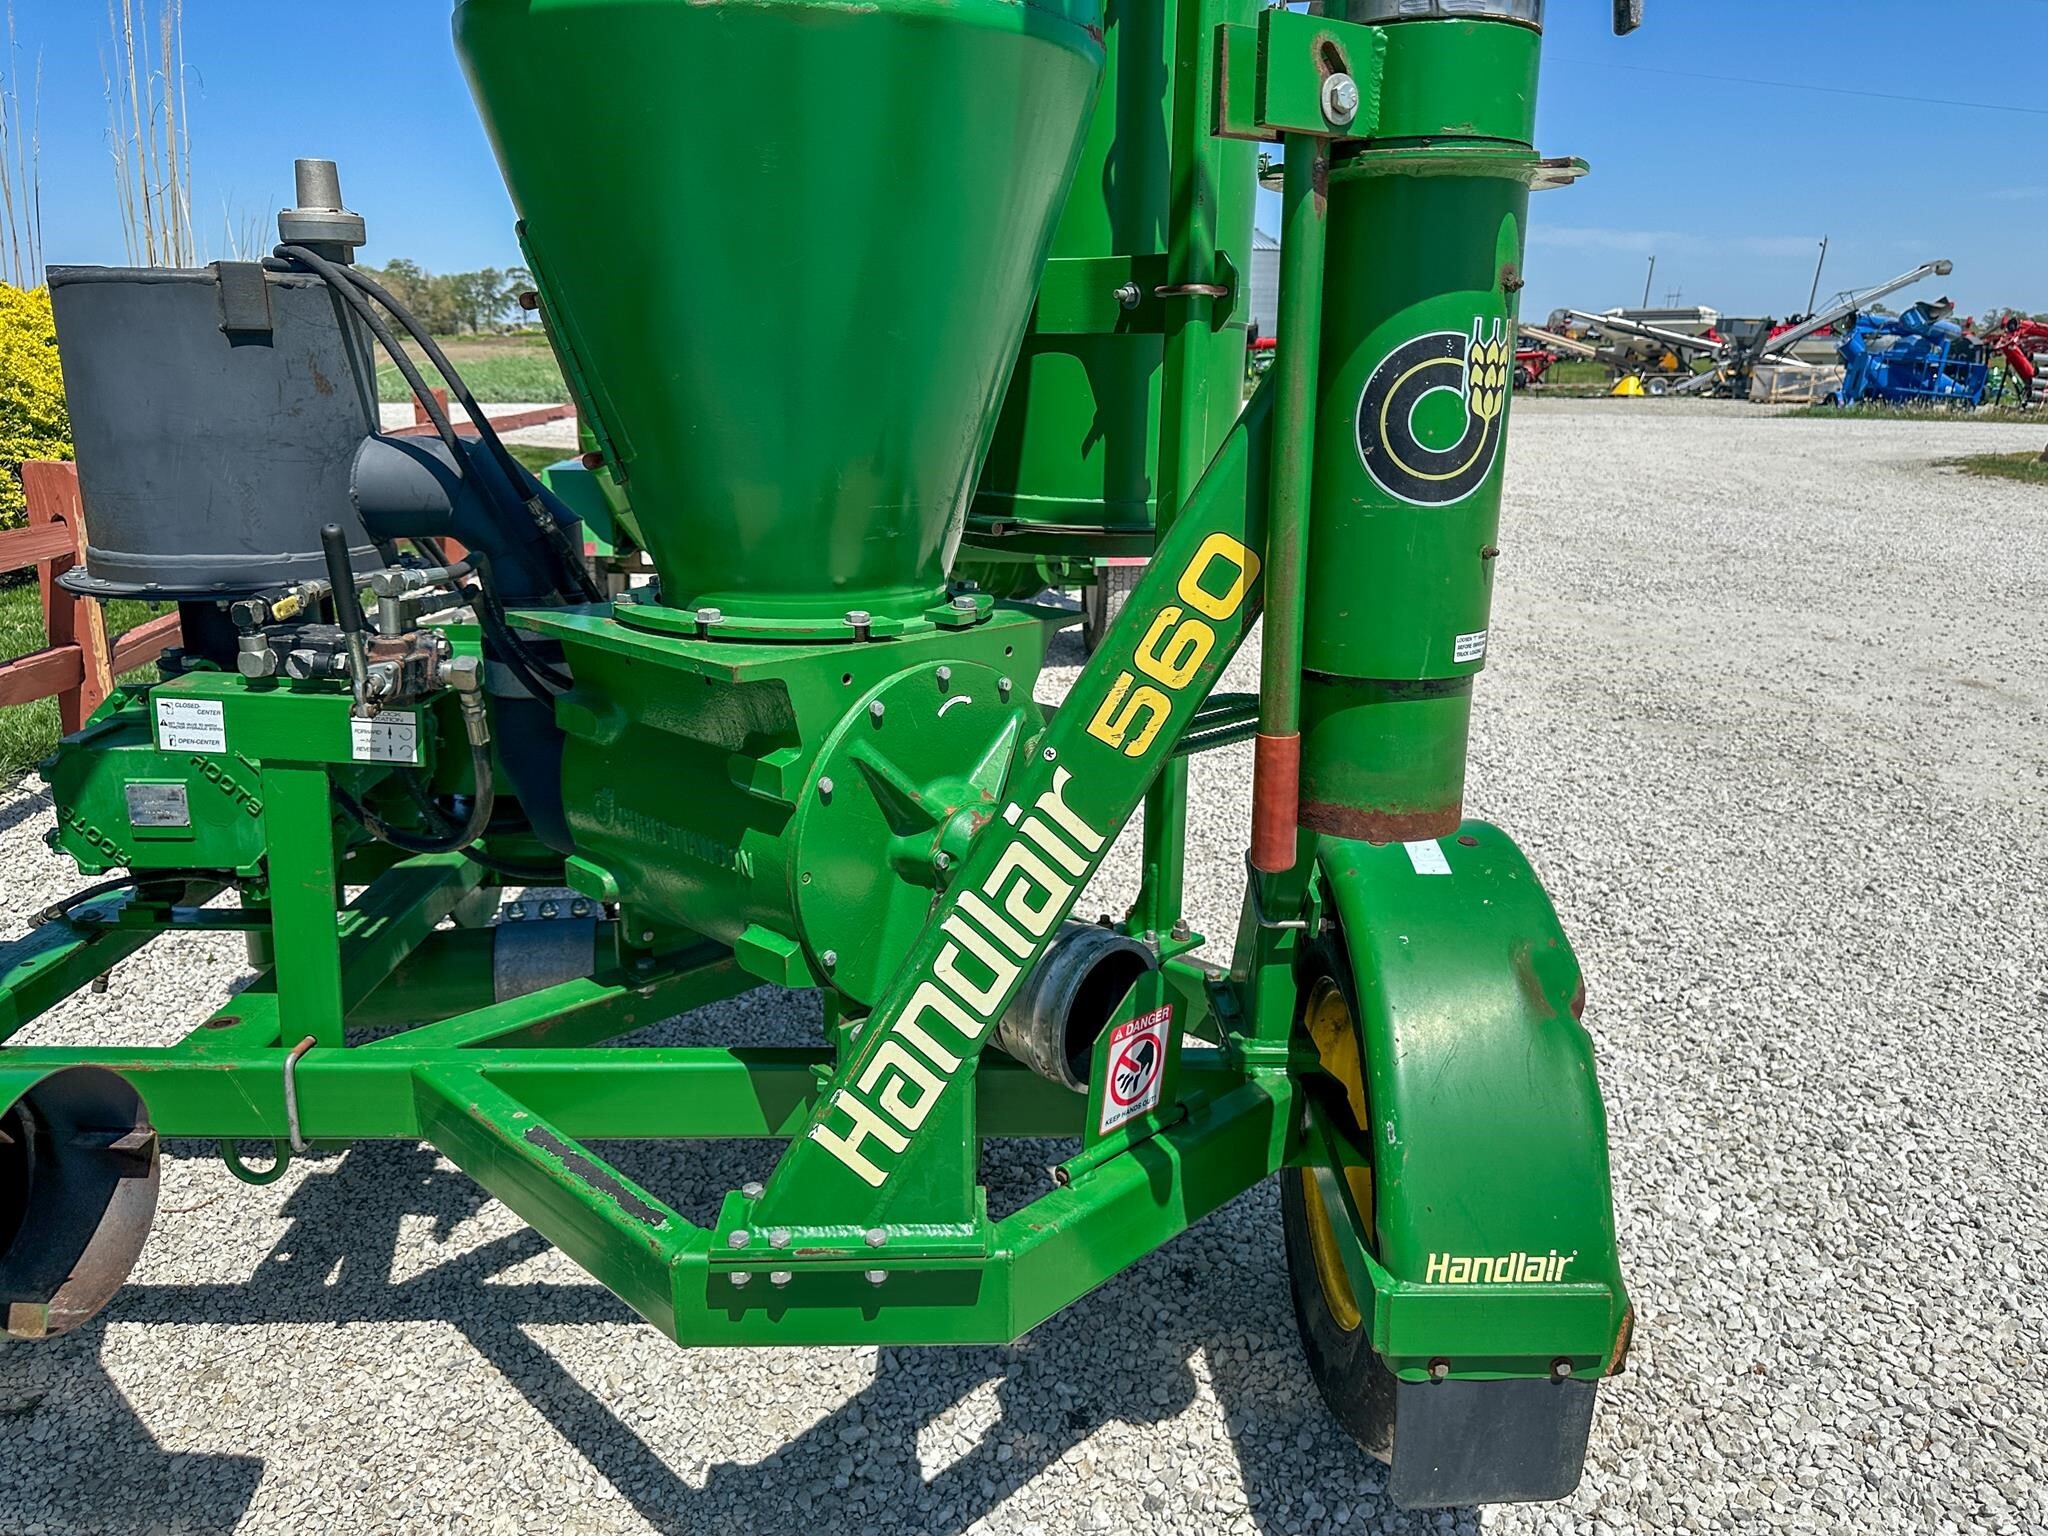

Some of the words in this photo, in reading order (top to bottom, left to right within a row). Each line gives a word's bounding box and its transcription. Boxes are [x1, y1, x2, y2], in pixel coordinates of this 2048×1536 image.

[1086, 532, 1261, 757] 560
[190, 755, 263, 818] ROOTS
[60, 804, 133, 867] ROOTS
[1125, 1007, 1169, 1036] DANGER
[1104, 1113, 1121, 1126] KEEP
[1122, 1102, 1142, 1117] HANDS
